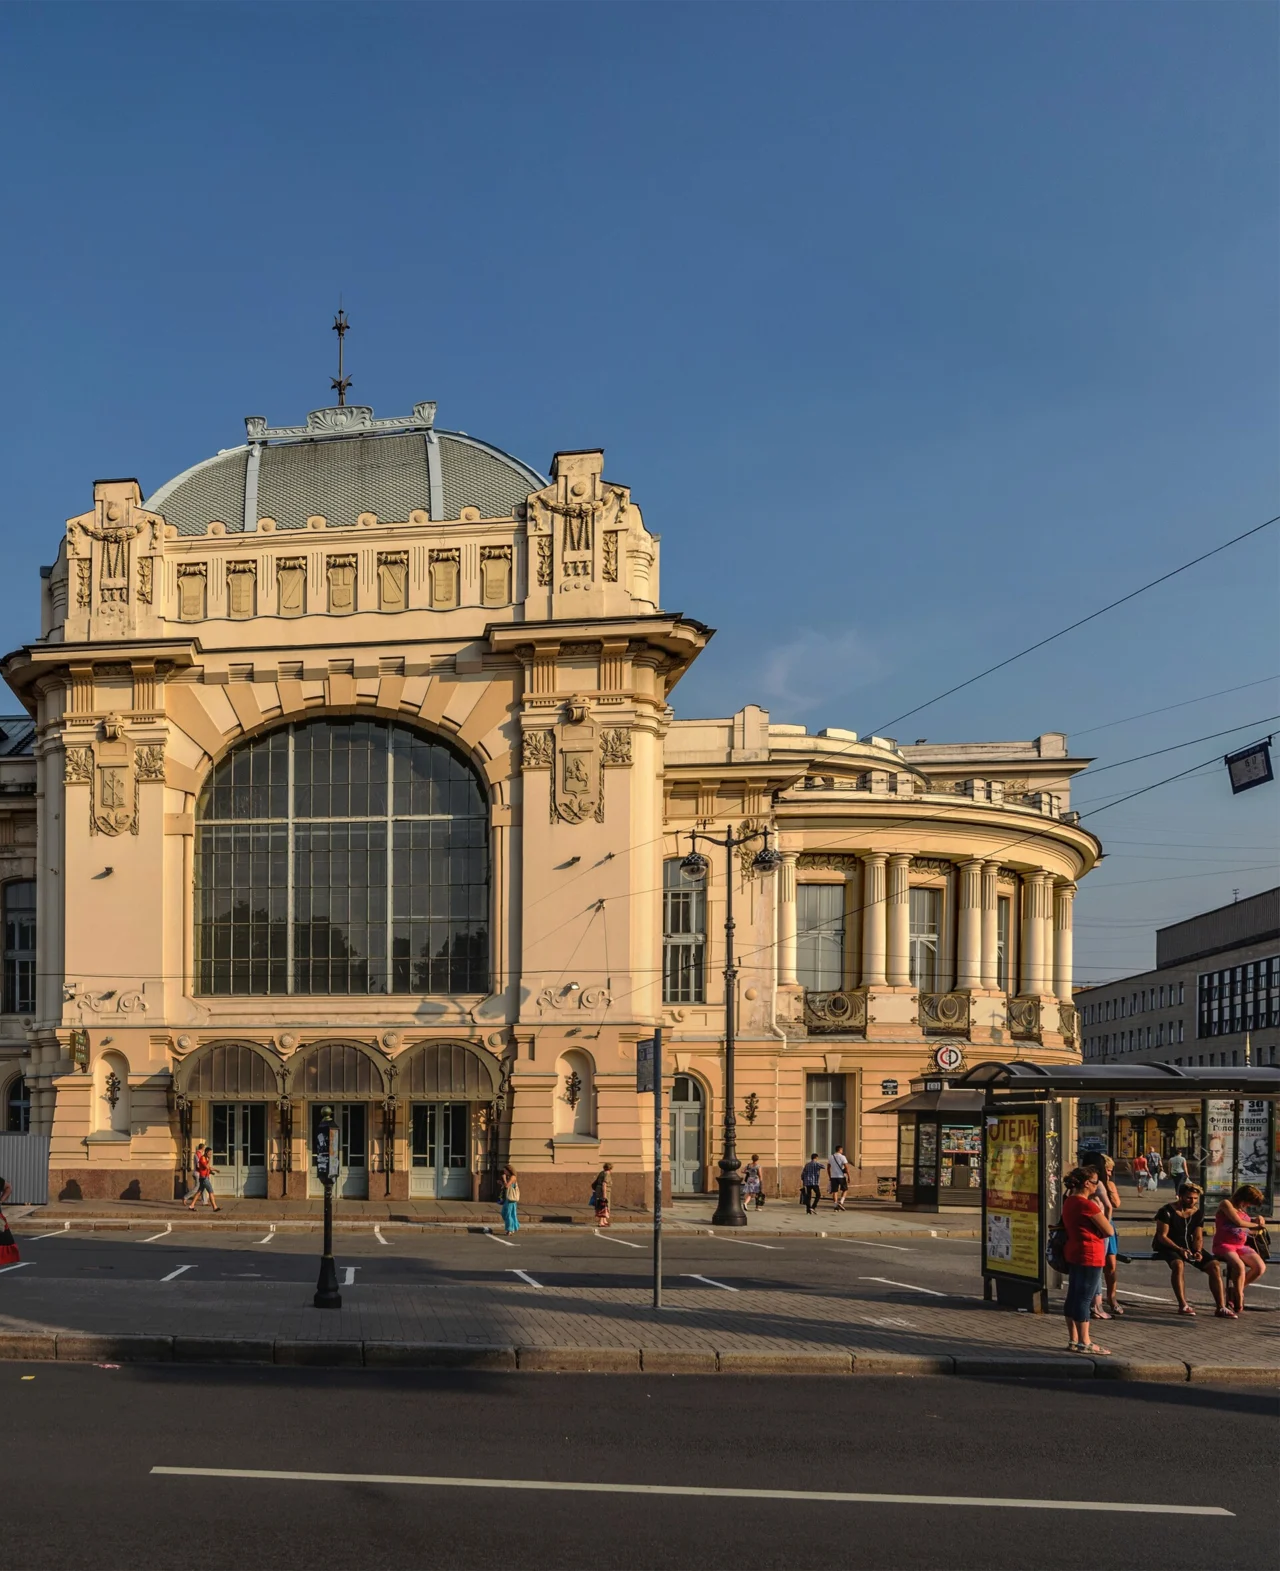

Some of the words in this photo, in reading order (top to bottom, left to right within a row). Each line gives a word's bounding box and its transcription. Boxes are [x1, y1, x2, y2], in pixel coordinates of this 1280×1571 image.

[1248, 1100, 1264, 1108] 30
[1209, 1116, 1268, 1124] Филипенко
[988, 1119, 1037, 1142] ОТЕЛИ
